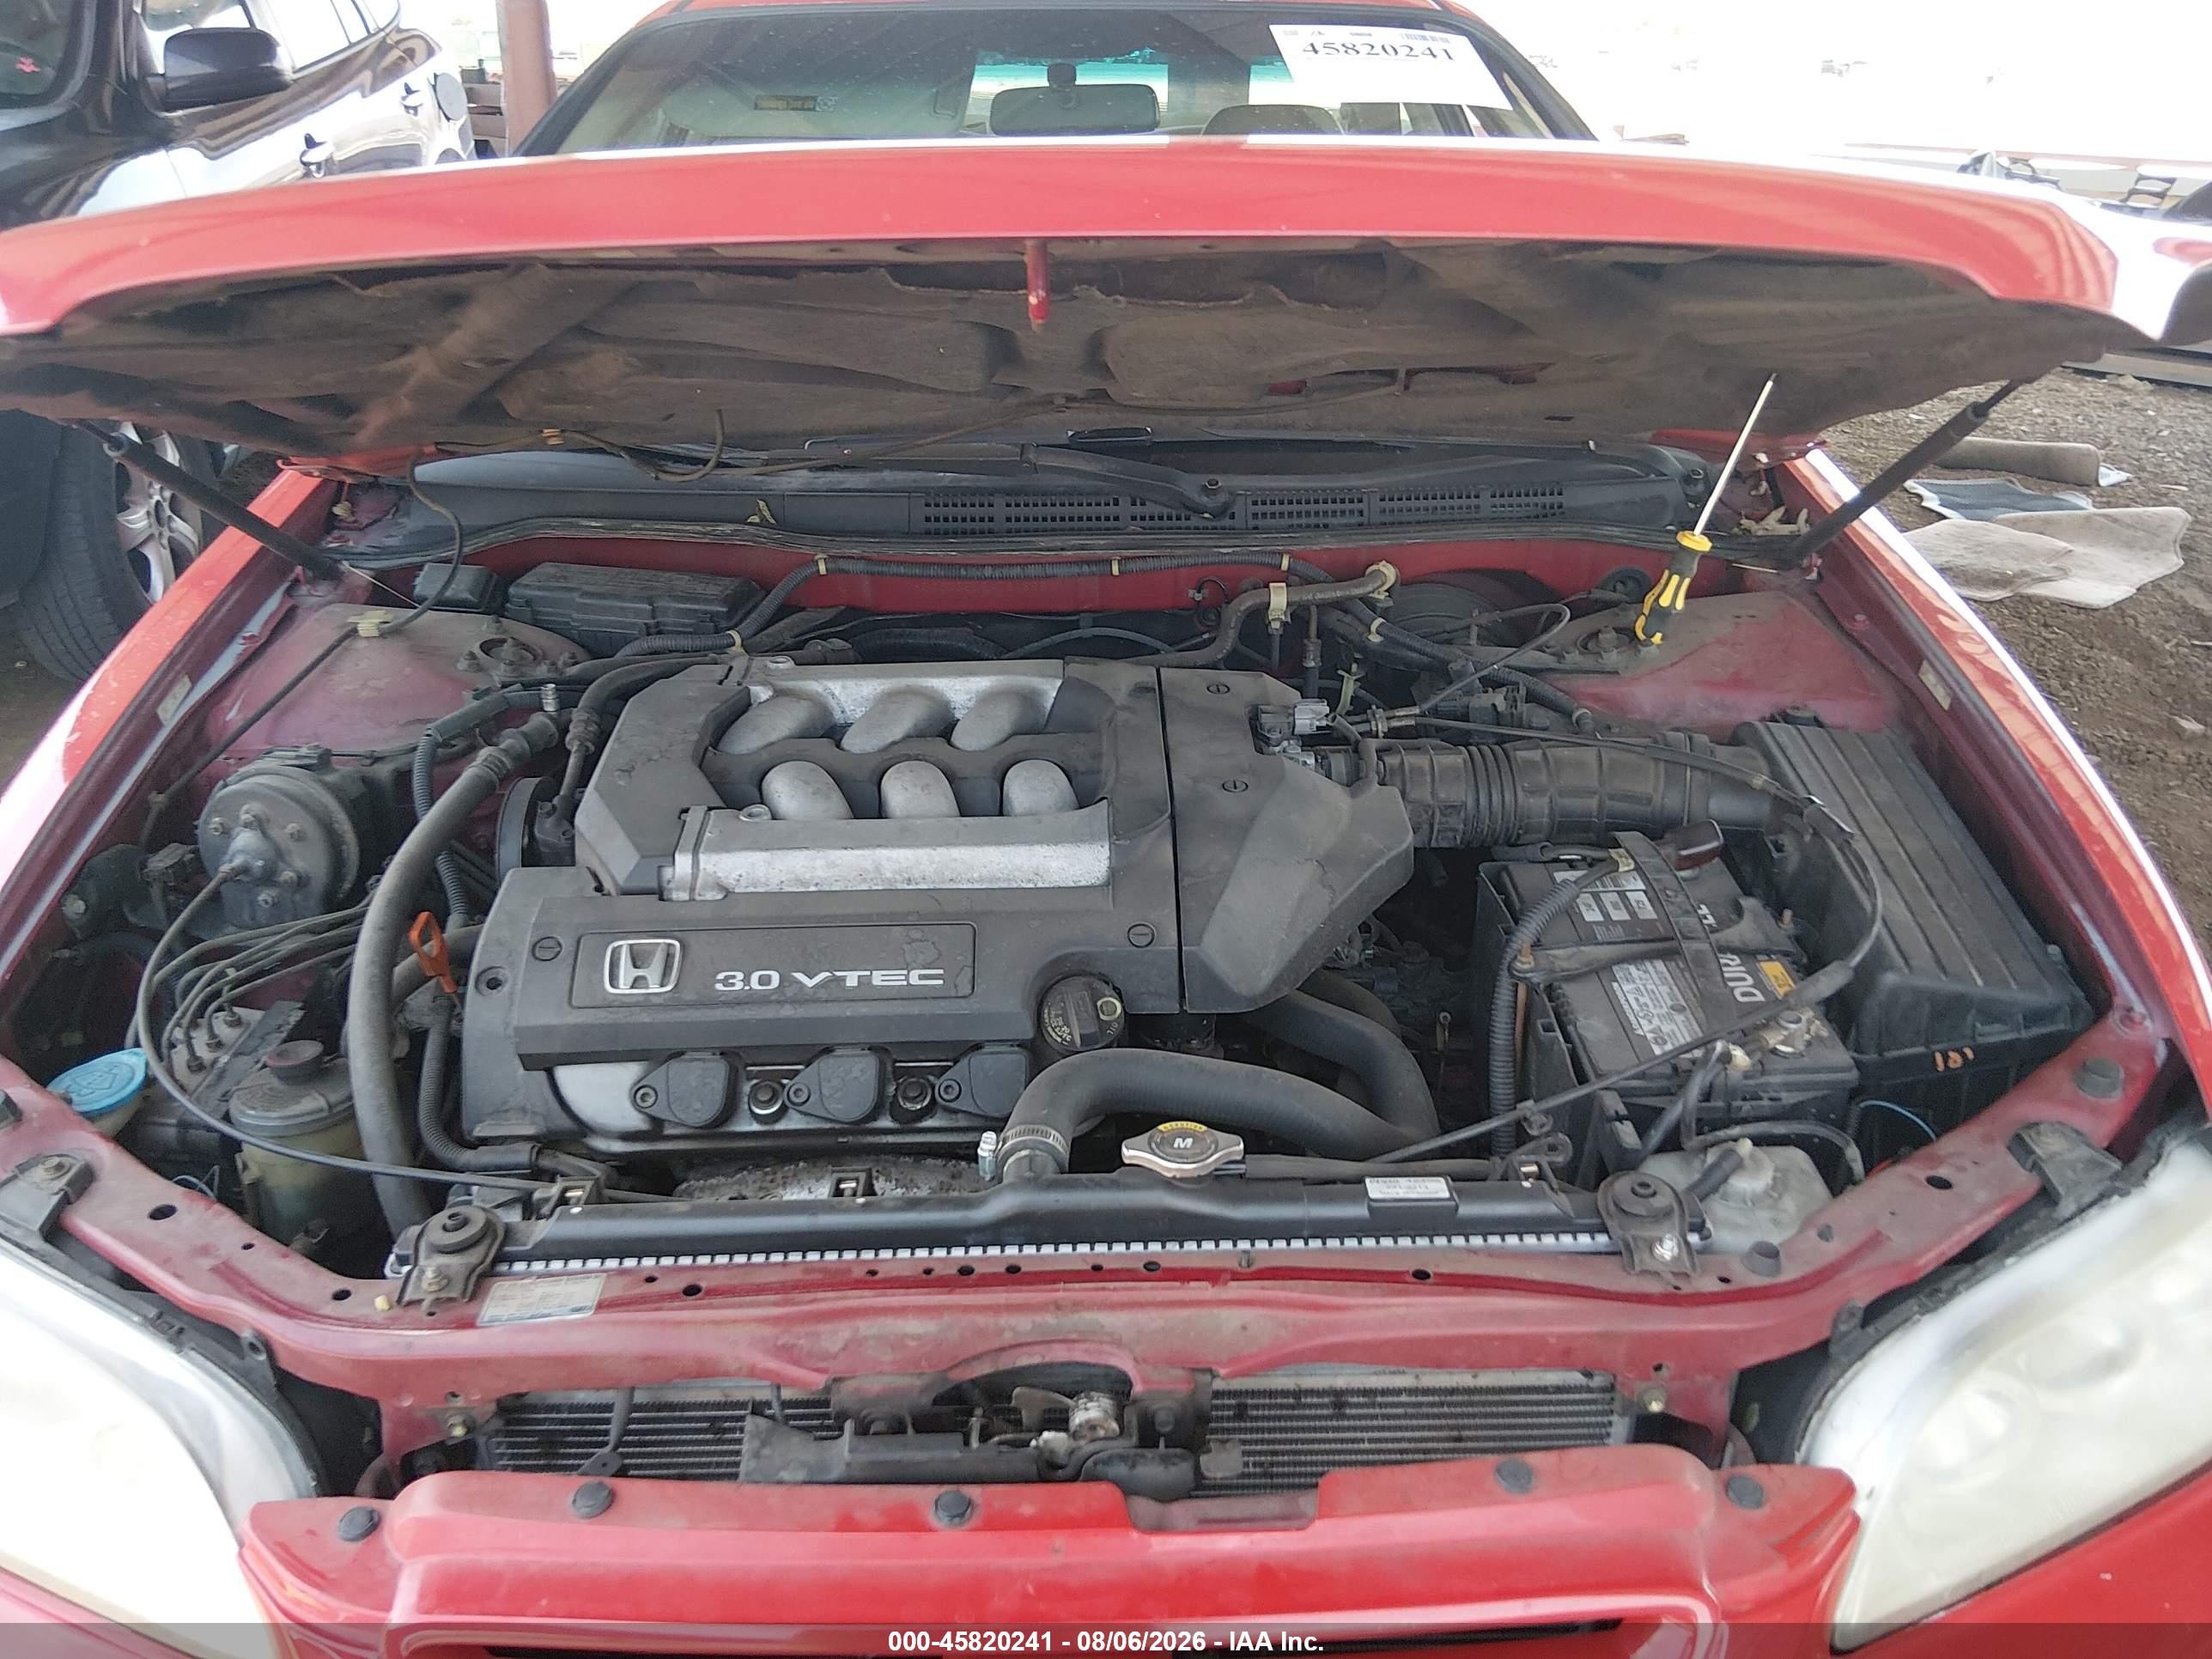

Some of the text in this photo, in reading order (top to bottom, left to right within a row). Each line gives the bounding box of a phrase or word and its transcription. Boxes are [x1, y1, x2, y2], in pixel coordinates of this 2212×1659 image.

[1303, 42, 1455, 61] 45820241
[714, 969, 945, 991] 3.0 VTEC
